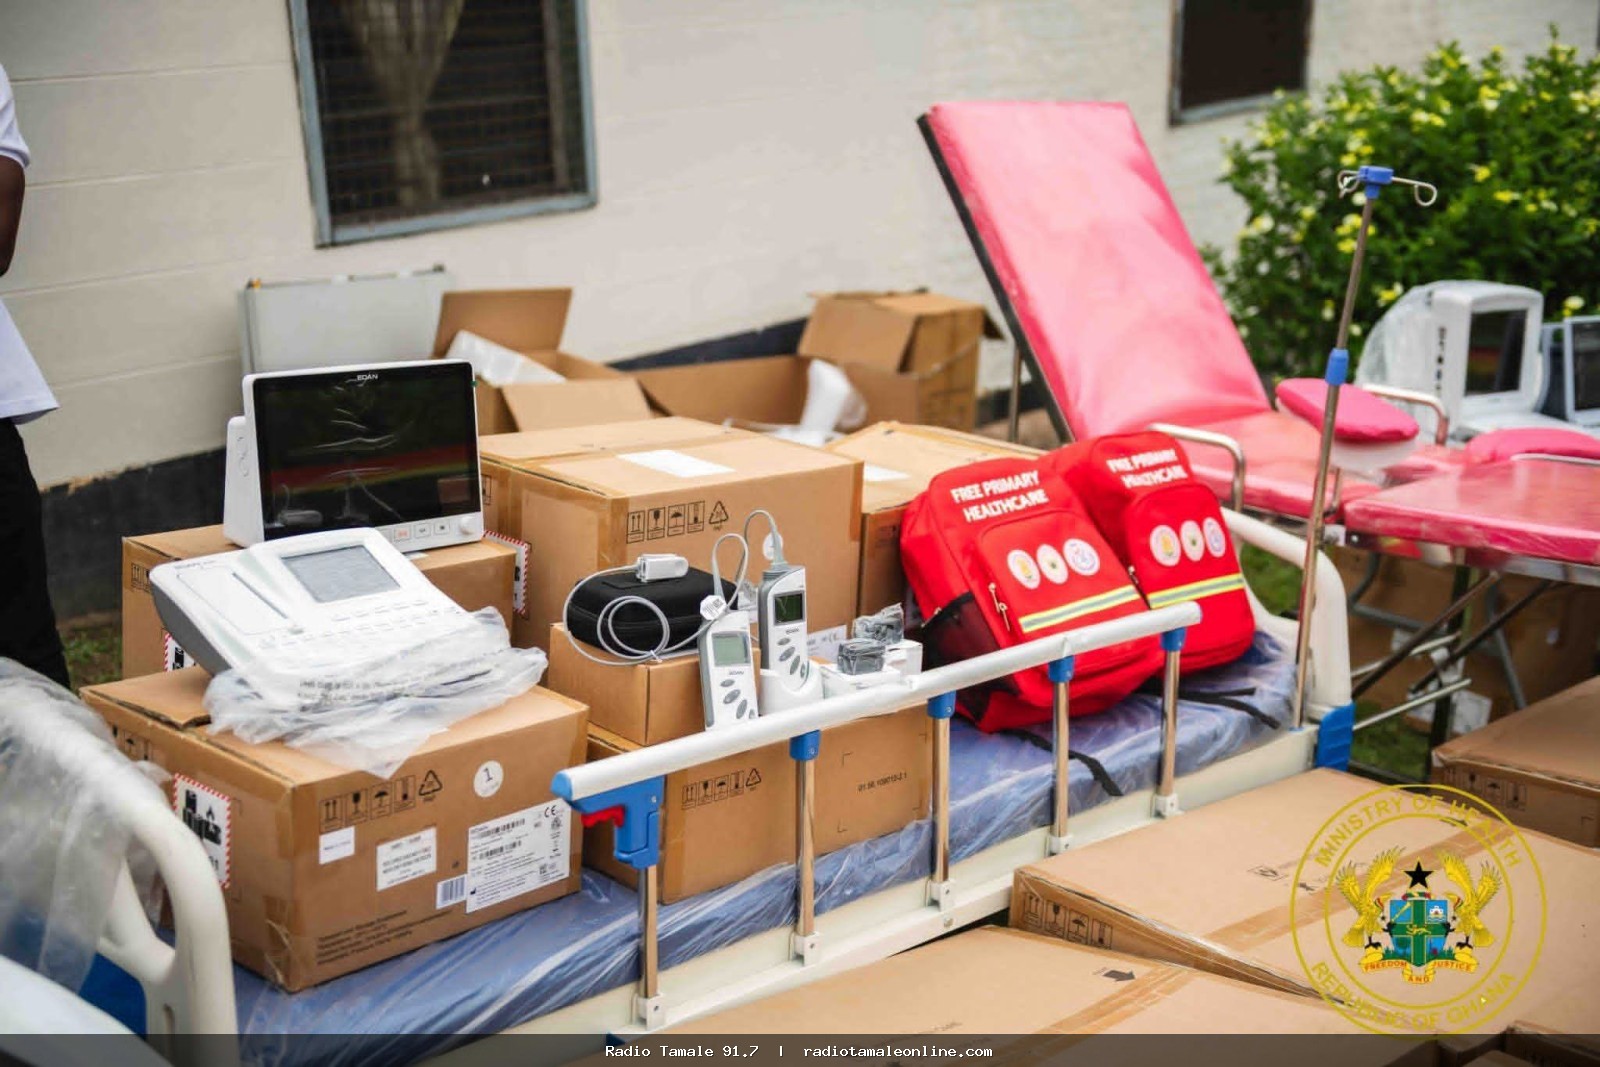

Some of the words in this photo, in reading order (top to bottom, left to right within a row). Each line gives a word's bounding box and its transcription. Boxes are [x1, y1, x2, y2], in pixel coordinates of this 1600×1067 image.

[357, 373, 379, 381] EDAN
[1106, 456, 1134, 474] FREE
[1121, 465, 1189, 490] HEALTHCARE
[950, 483, 984, 504] FREE
[981, 470, 1039, 496] PRIMARY
[963, 488, 1050, 523] HEALTHCARE
